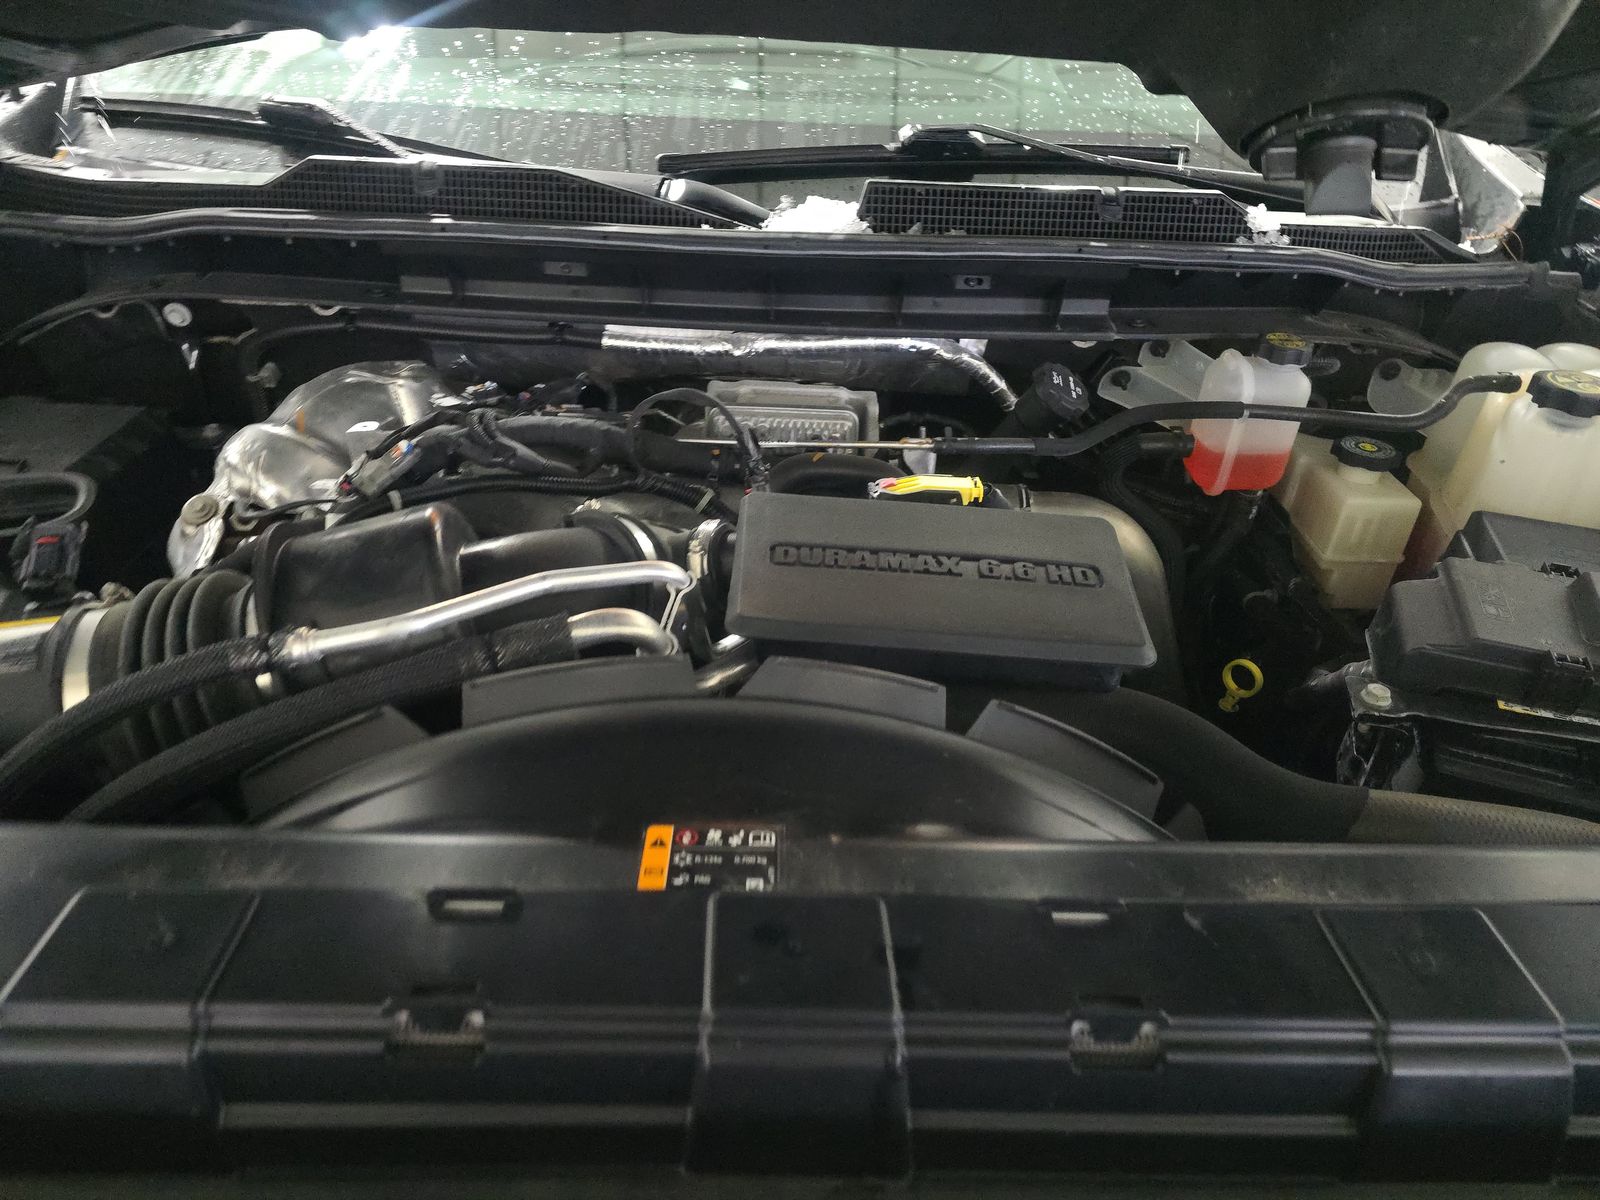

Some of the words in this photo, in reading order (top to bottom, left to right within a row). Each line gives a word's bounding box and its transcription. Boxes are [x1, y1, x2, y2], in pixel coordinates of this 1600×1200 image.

[772, 545, 963, 577] DURAMAX
[977, 557, 1037, 583] 6.6
[1046, 563, 1099, 588] HD
